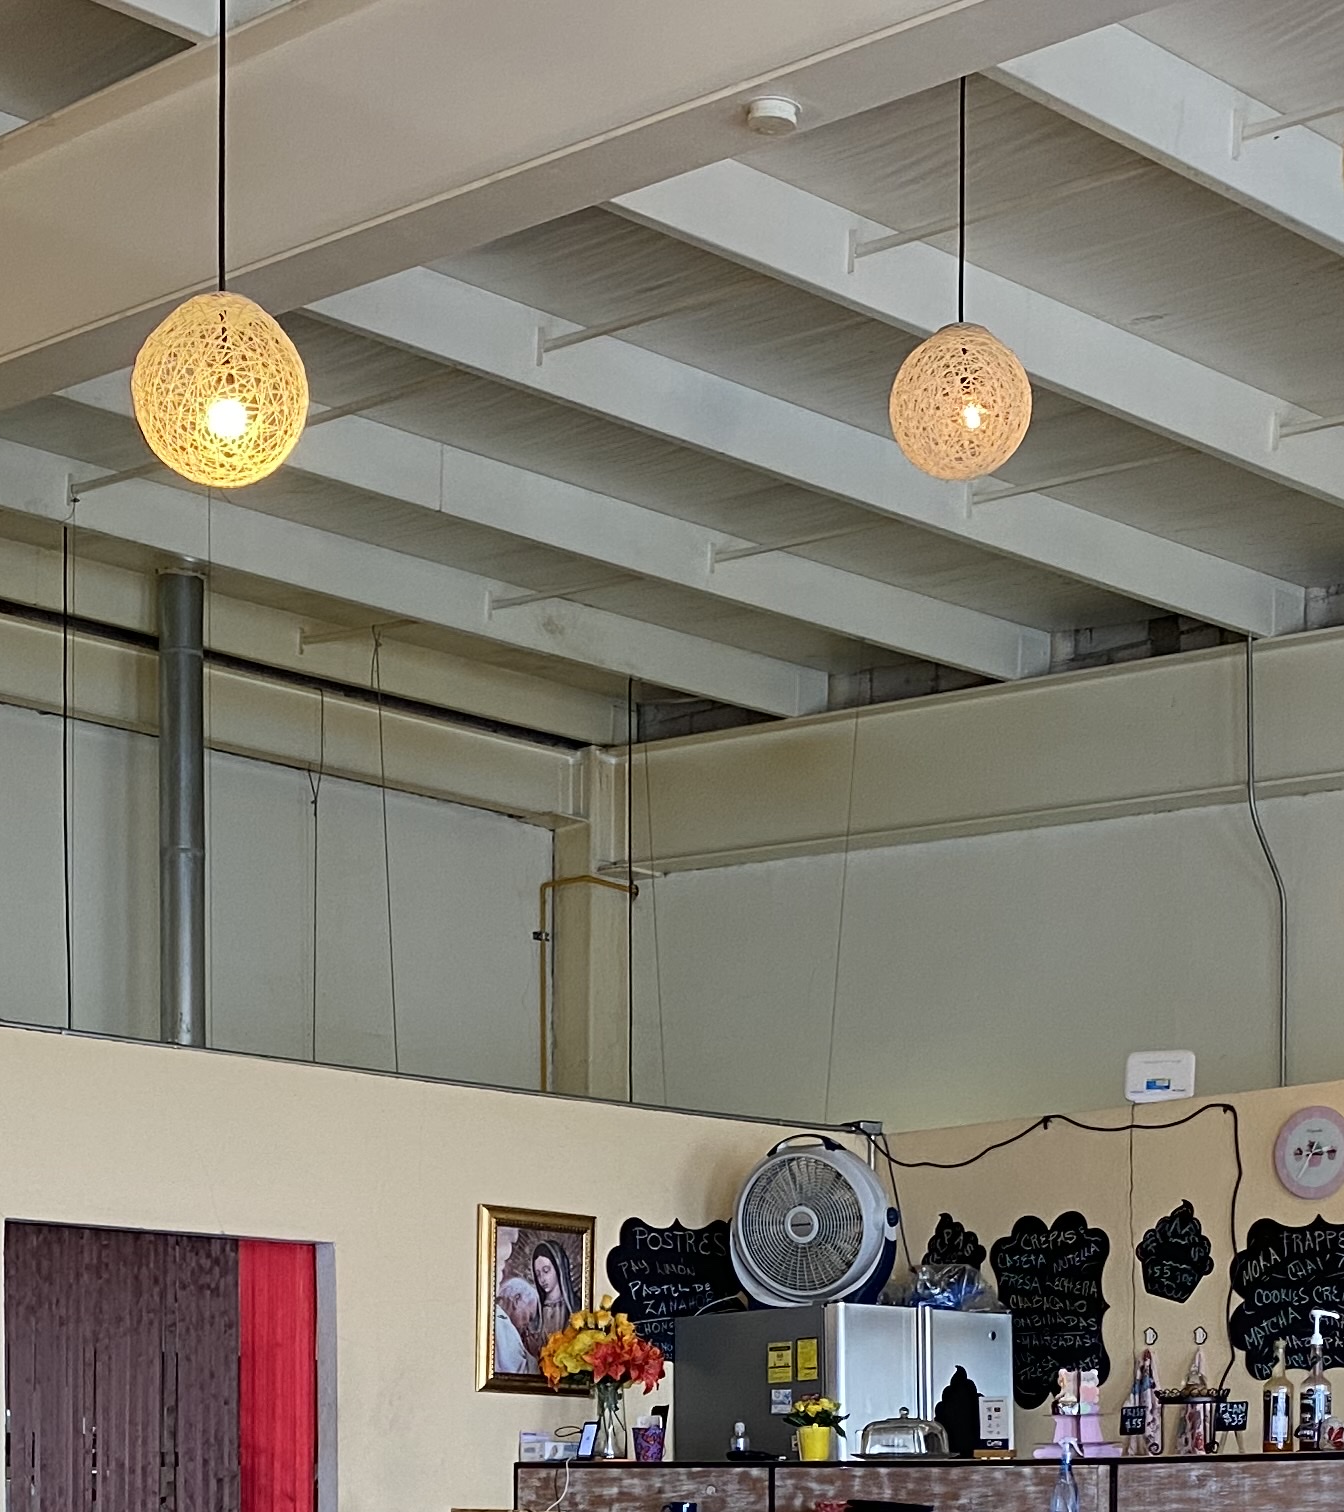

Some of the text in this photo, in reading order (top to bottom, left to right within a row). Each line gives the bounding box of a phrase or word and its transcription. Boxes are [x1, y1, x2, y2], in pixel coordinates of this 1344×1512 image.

[632, 1227, 727, 1257] POSTRES
[1020, 1230, 1077, 1250] CREPAS
[1242, 1247, 1281, 1286] MOKA
[628, 1280, 710, 1300] PASTEL DE
[999, 1272, 1042, 1295] FRESA
[1254, 1287, 1309, 1306] COOKIES
[1244, 1307, 1302, 1351] MATCHA
[1219, 1402, 1246, 1414] FLAN
